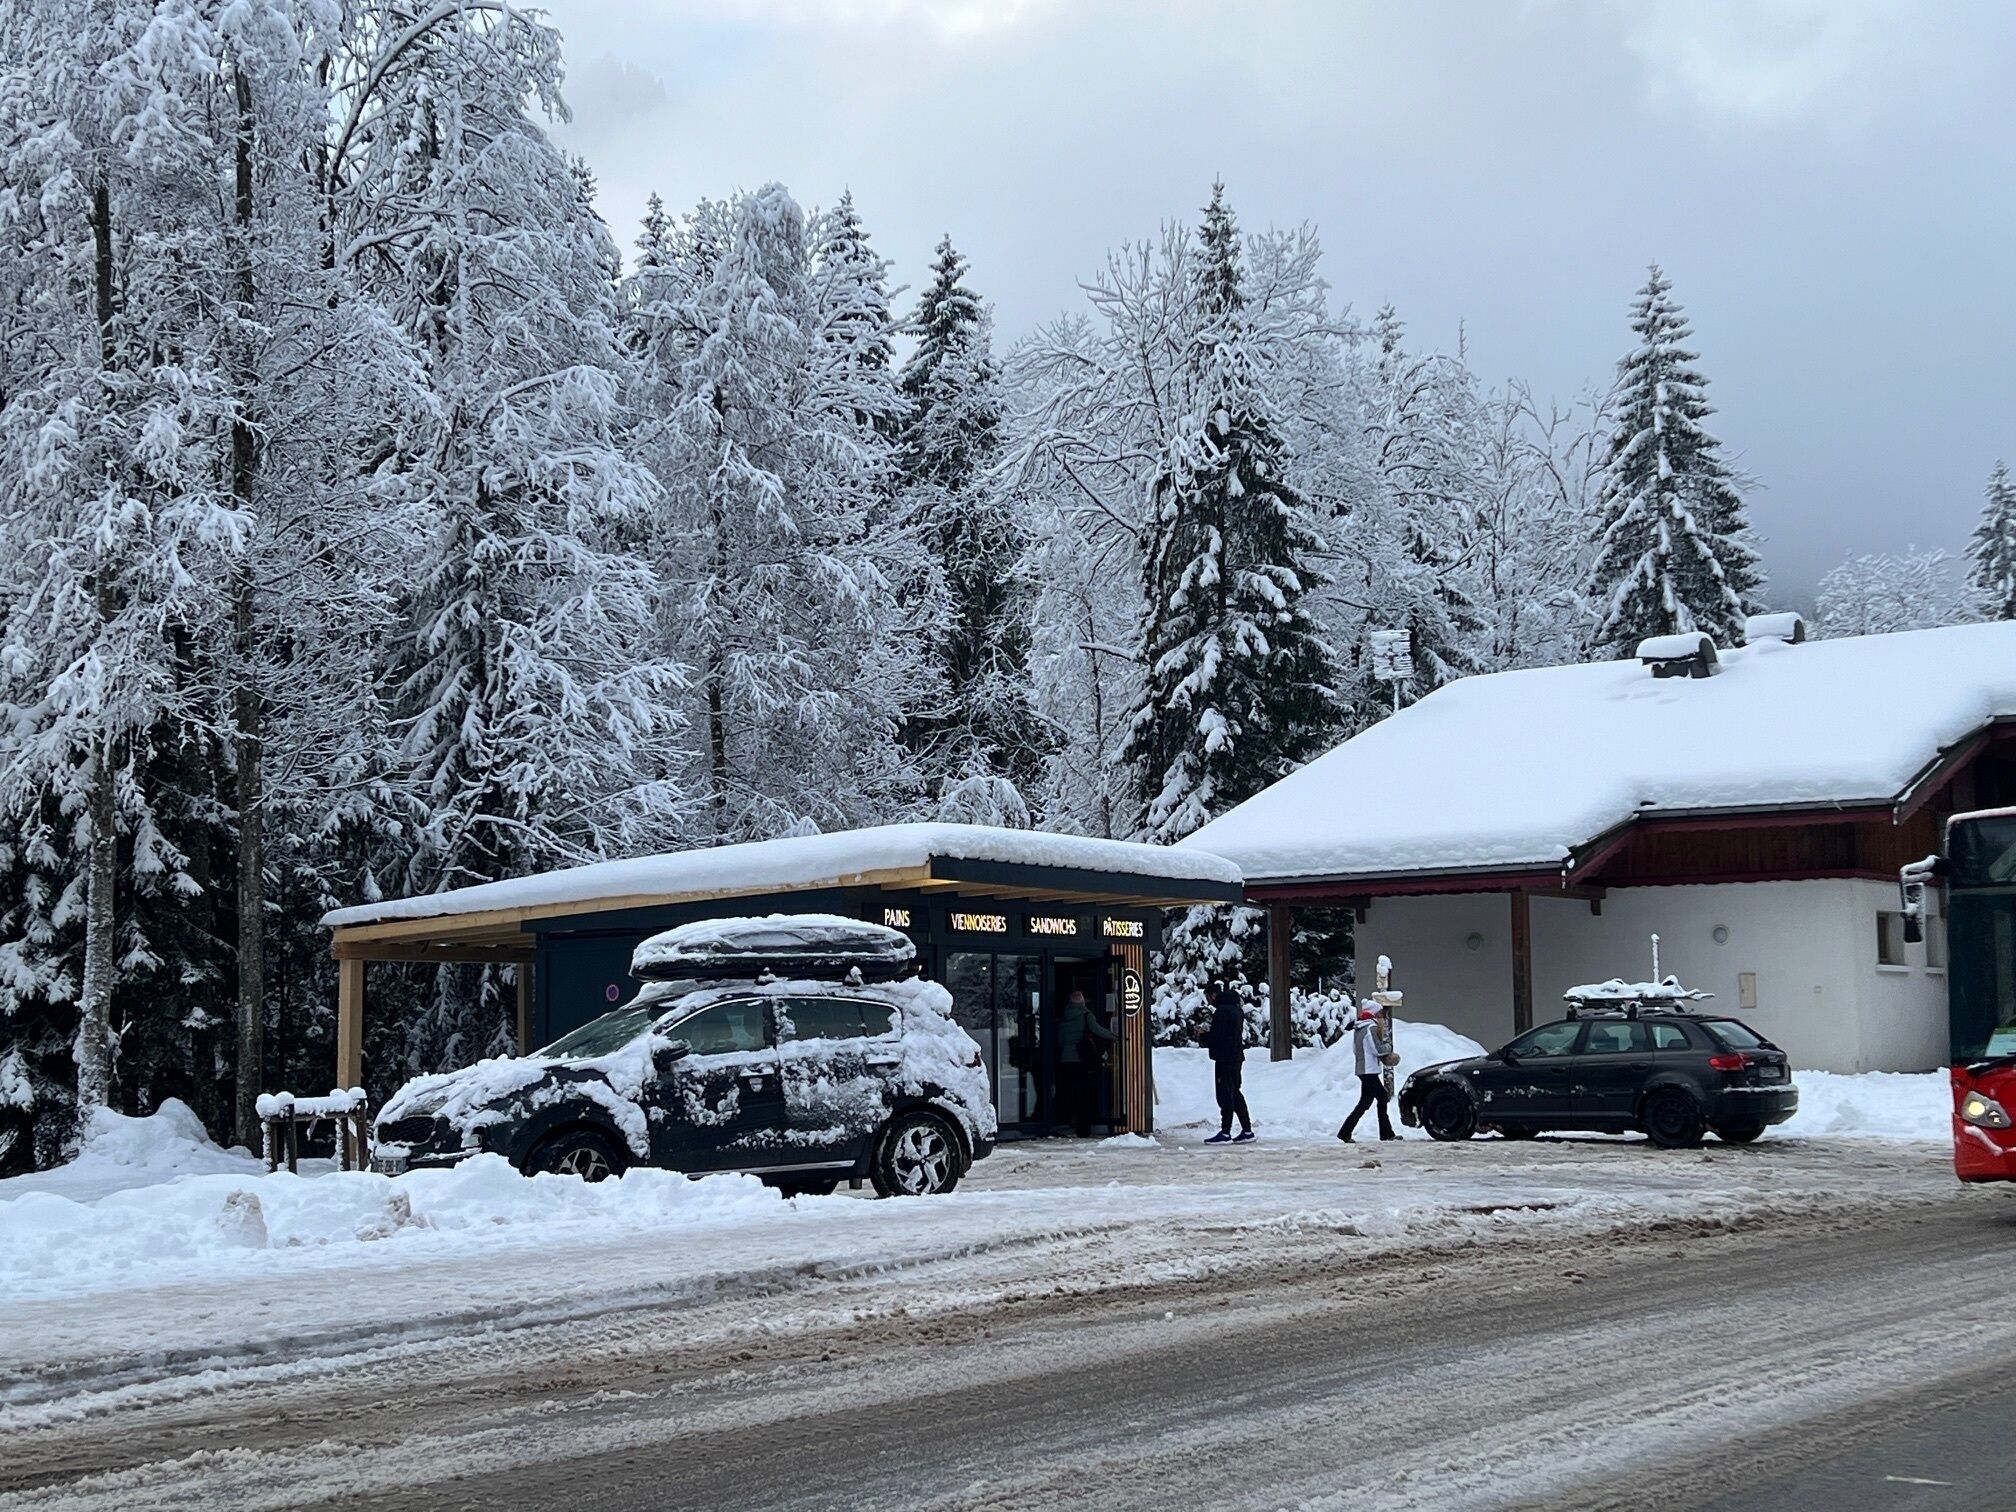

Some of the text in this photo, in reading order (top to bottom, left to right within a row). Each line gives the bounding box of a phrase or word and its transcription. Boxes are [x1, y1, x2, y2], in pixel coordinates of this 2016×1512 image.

[884, 908, 910, 927] PAINS
[950, 912, 1007, 932] VIENNOISERIES
[1030, 917, 1077, 935] SANDWICHS
[1103, 916, 1143, 938] PÂTISSERIES
